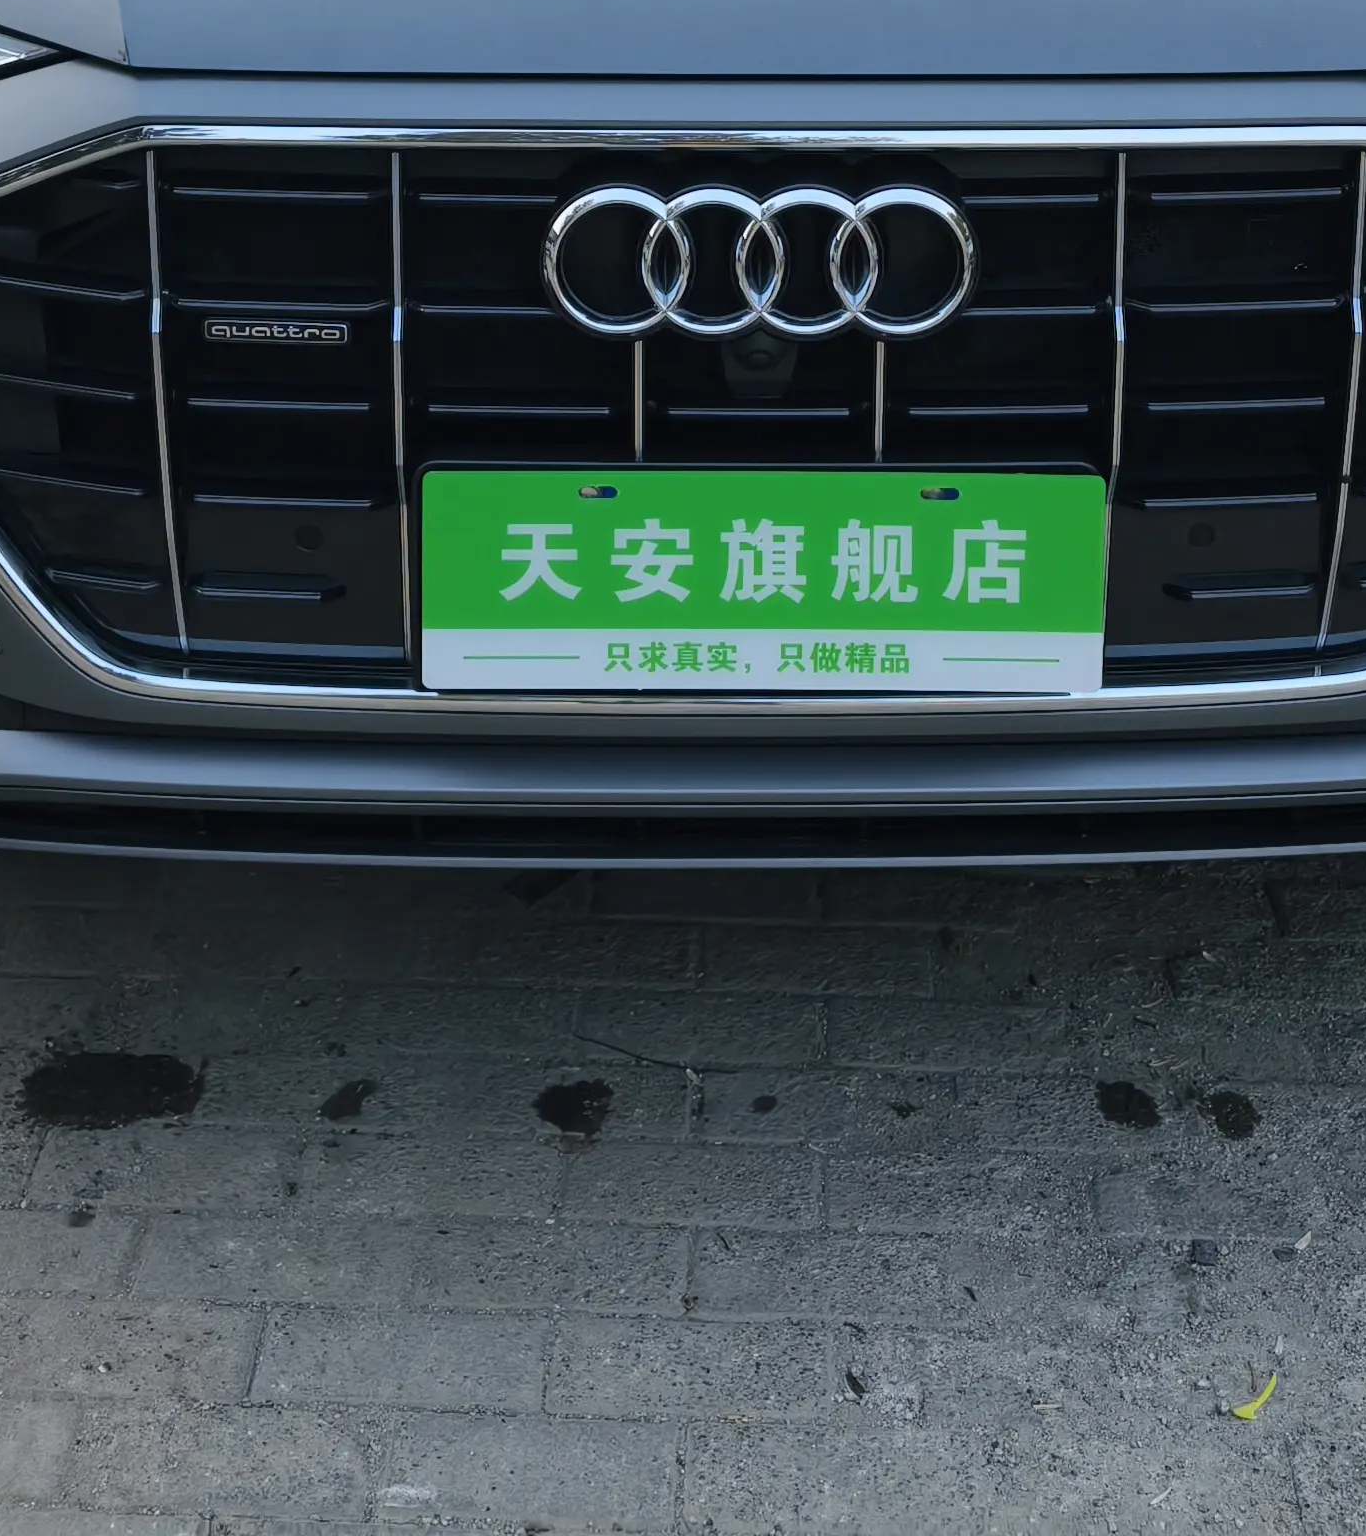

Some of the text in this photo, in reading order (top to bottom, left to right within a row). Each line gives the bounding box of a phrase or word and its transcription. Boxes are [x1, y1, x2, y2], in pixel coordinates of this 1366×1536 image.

[211, 325, 340, 339] quattro
[499, 518, 1027, 604] 天安旗舰店
